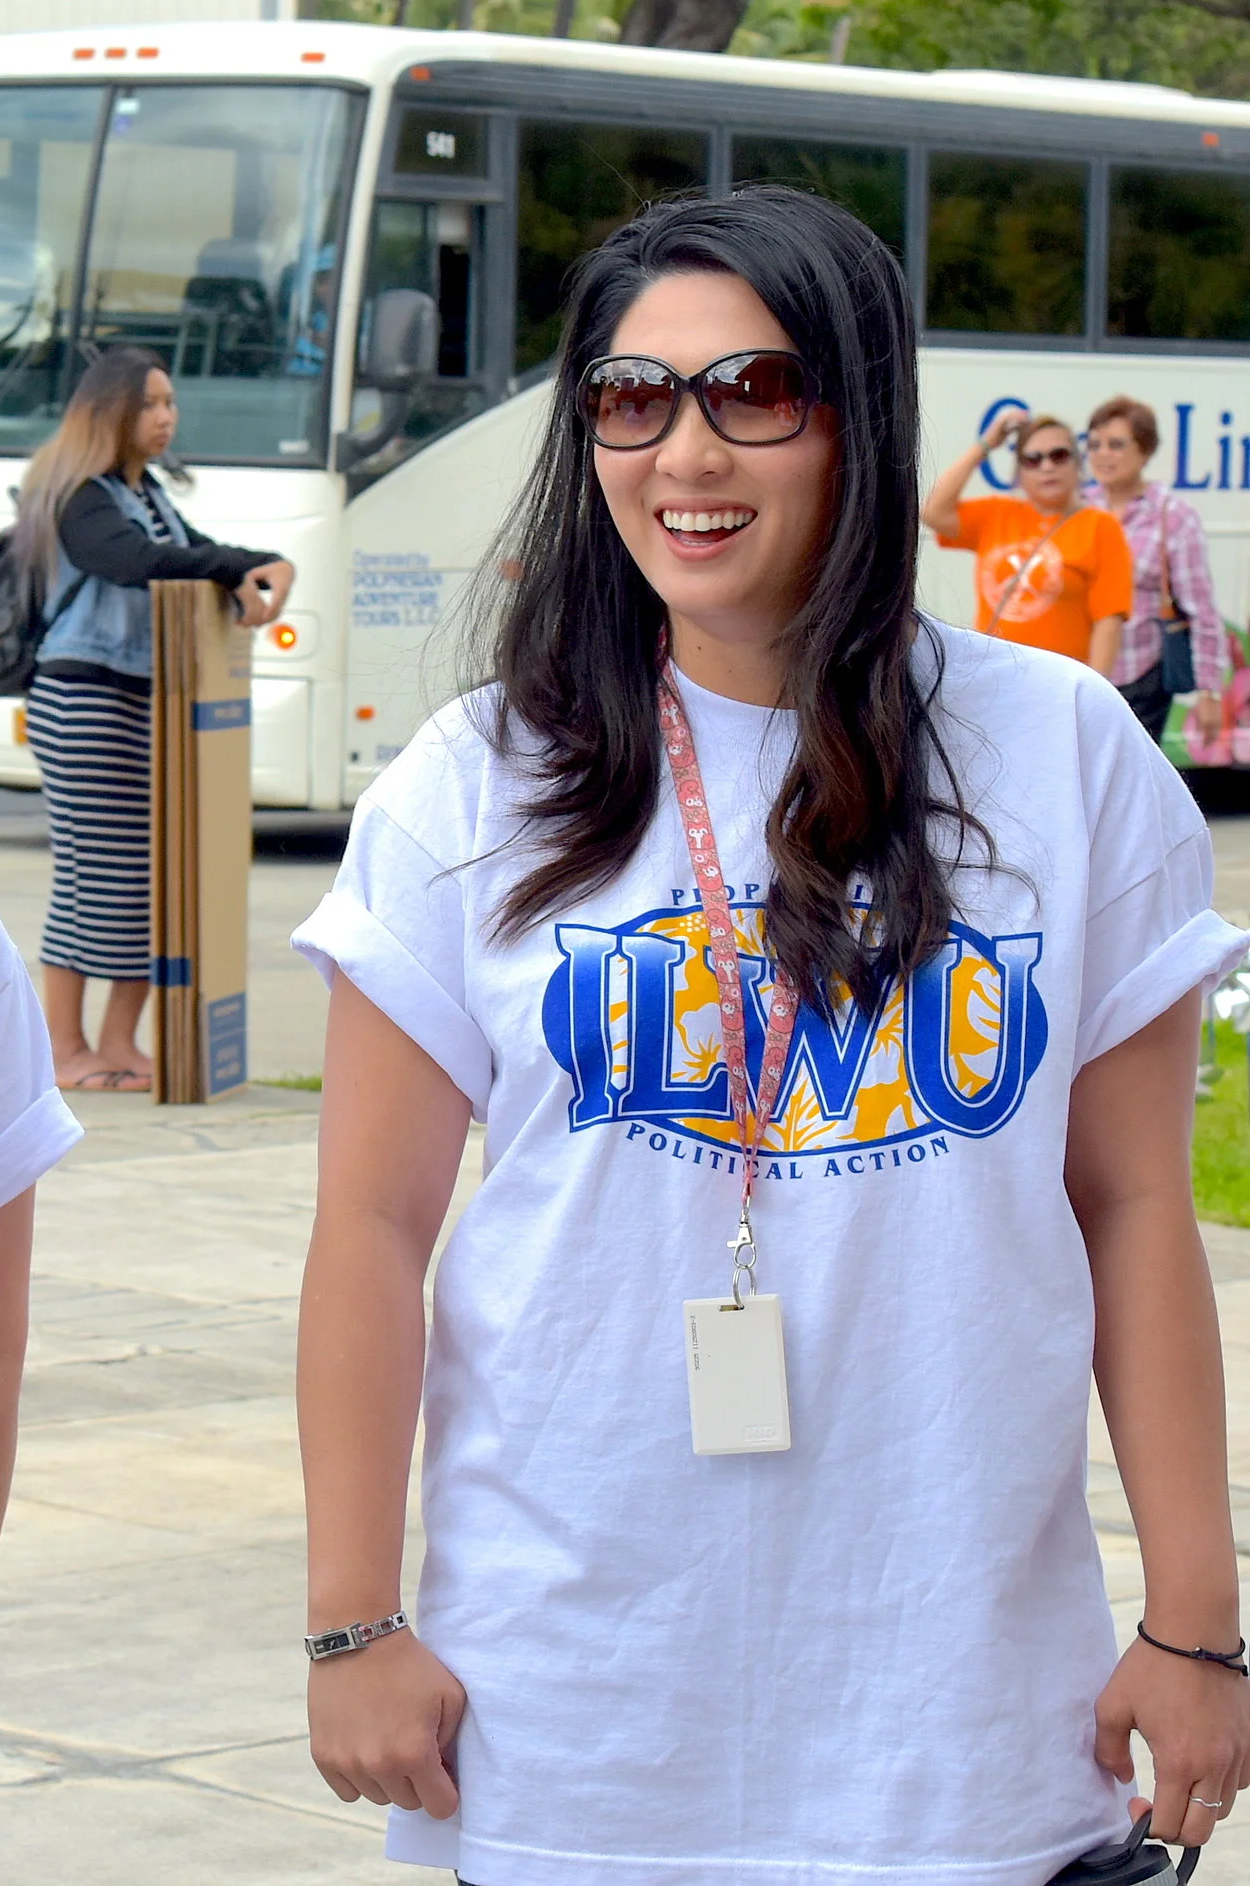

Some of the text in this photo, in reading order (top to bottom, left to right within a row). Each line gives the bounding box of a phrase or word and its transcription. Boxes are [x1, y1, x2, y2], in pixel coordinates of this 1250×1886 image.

[554, 922, 1043, 1140] ILWU
[625, 1122, 950, 1180] POLITICAL ACTION
